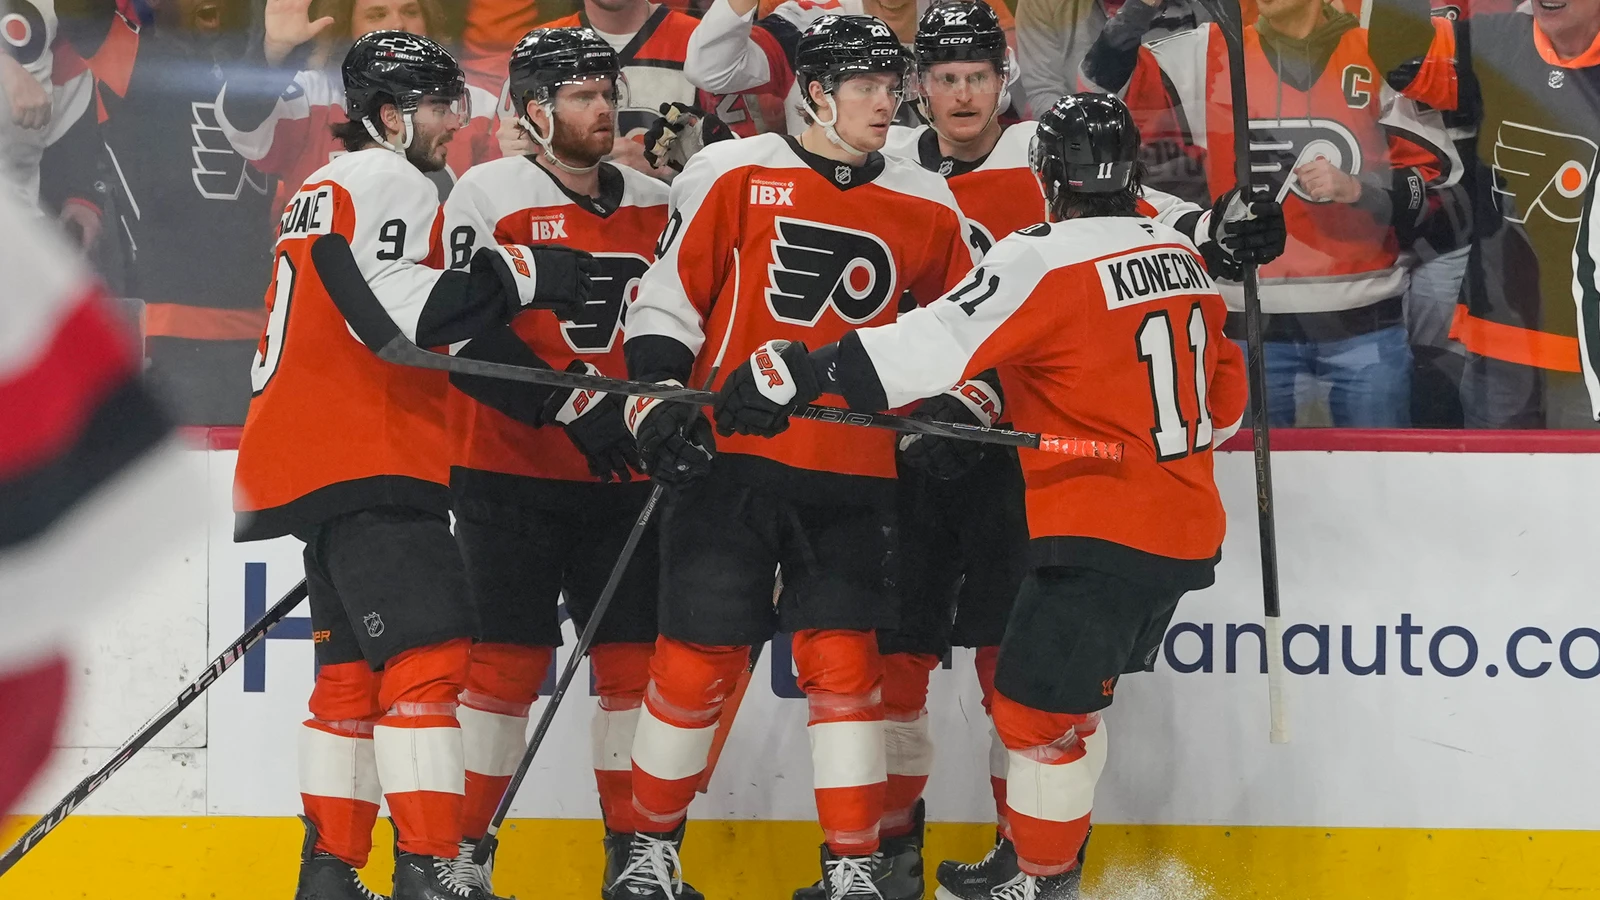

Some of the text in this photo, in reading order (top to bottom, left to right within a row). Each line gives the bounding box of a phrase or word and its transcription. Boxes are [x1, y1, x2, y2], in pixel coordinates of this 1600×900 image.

[866, 25, 891, 37] 20
[944, 12, 967, 25] 22
[940, 37, 973, 45] CCM
[1341, 63, 1372, 109] C
[751, 178, 787, 187] Independence
[1097, 162, 1113, 179] 11
[749, 184, 794, 207] IBX
[376, 218, 407, 260] 9
[450, 225, 476, 269] 8
[531, 219, 569, 240] IBX
[654, 207, 683, 260] 0
[946, 266, 1001, 317] 11
[1135, 301, 1213, 462] 11
[1254, 428, 1265, 481] GHOST
[1163, 613, 1600, 680] anauto.co
